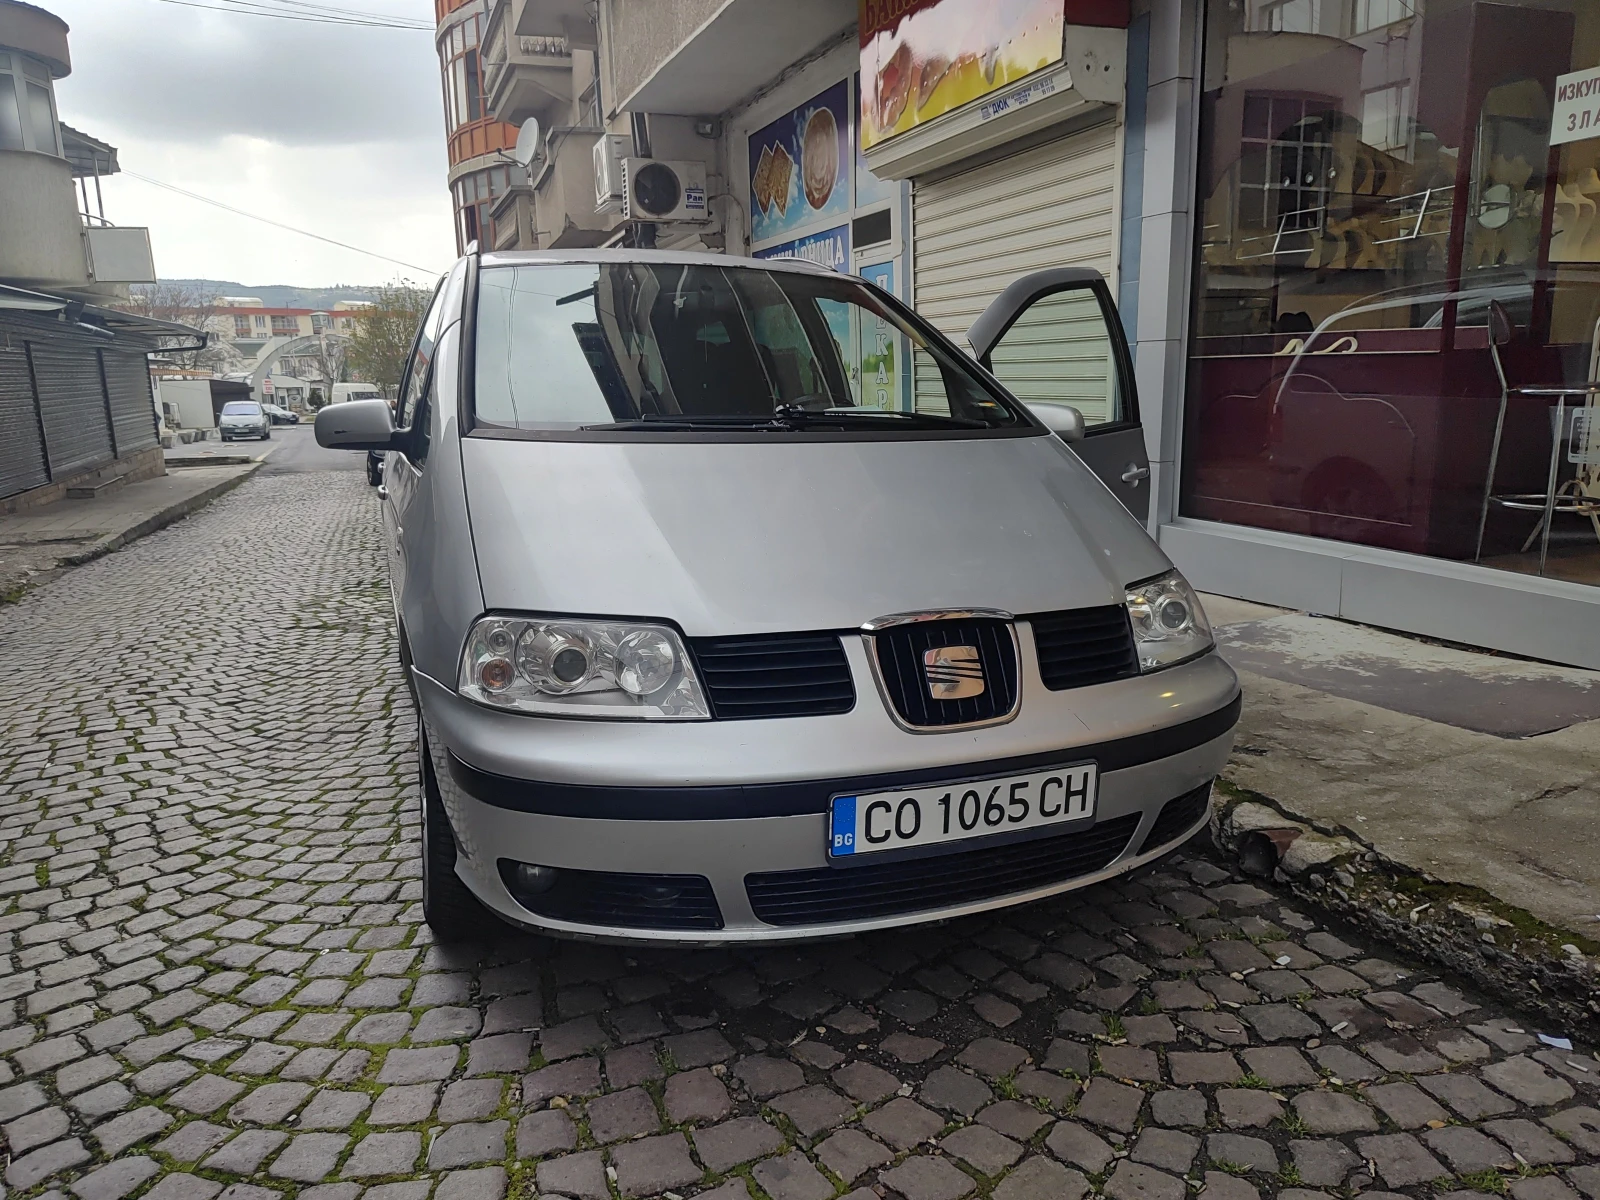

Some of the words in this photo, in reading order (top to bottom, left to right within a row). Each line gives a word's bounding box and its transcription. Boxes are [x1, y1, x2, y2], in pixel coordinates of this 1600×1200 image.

[865, 797, 921, 844] CO
[938, 781, 1030, 835] 1065
[1039, 771, 1089, 818] CH
[834, 833, 853, 847] BG
